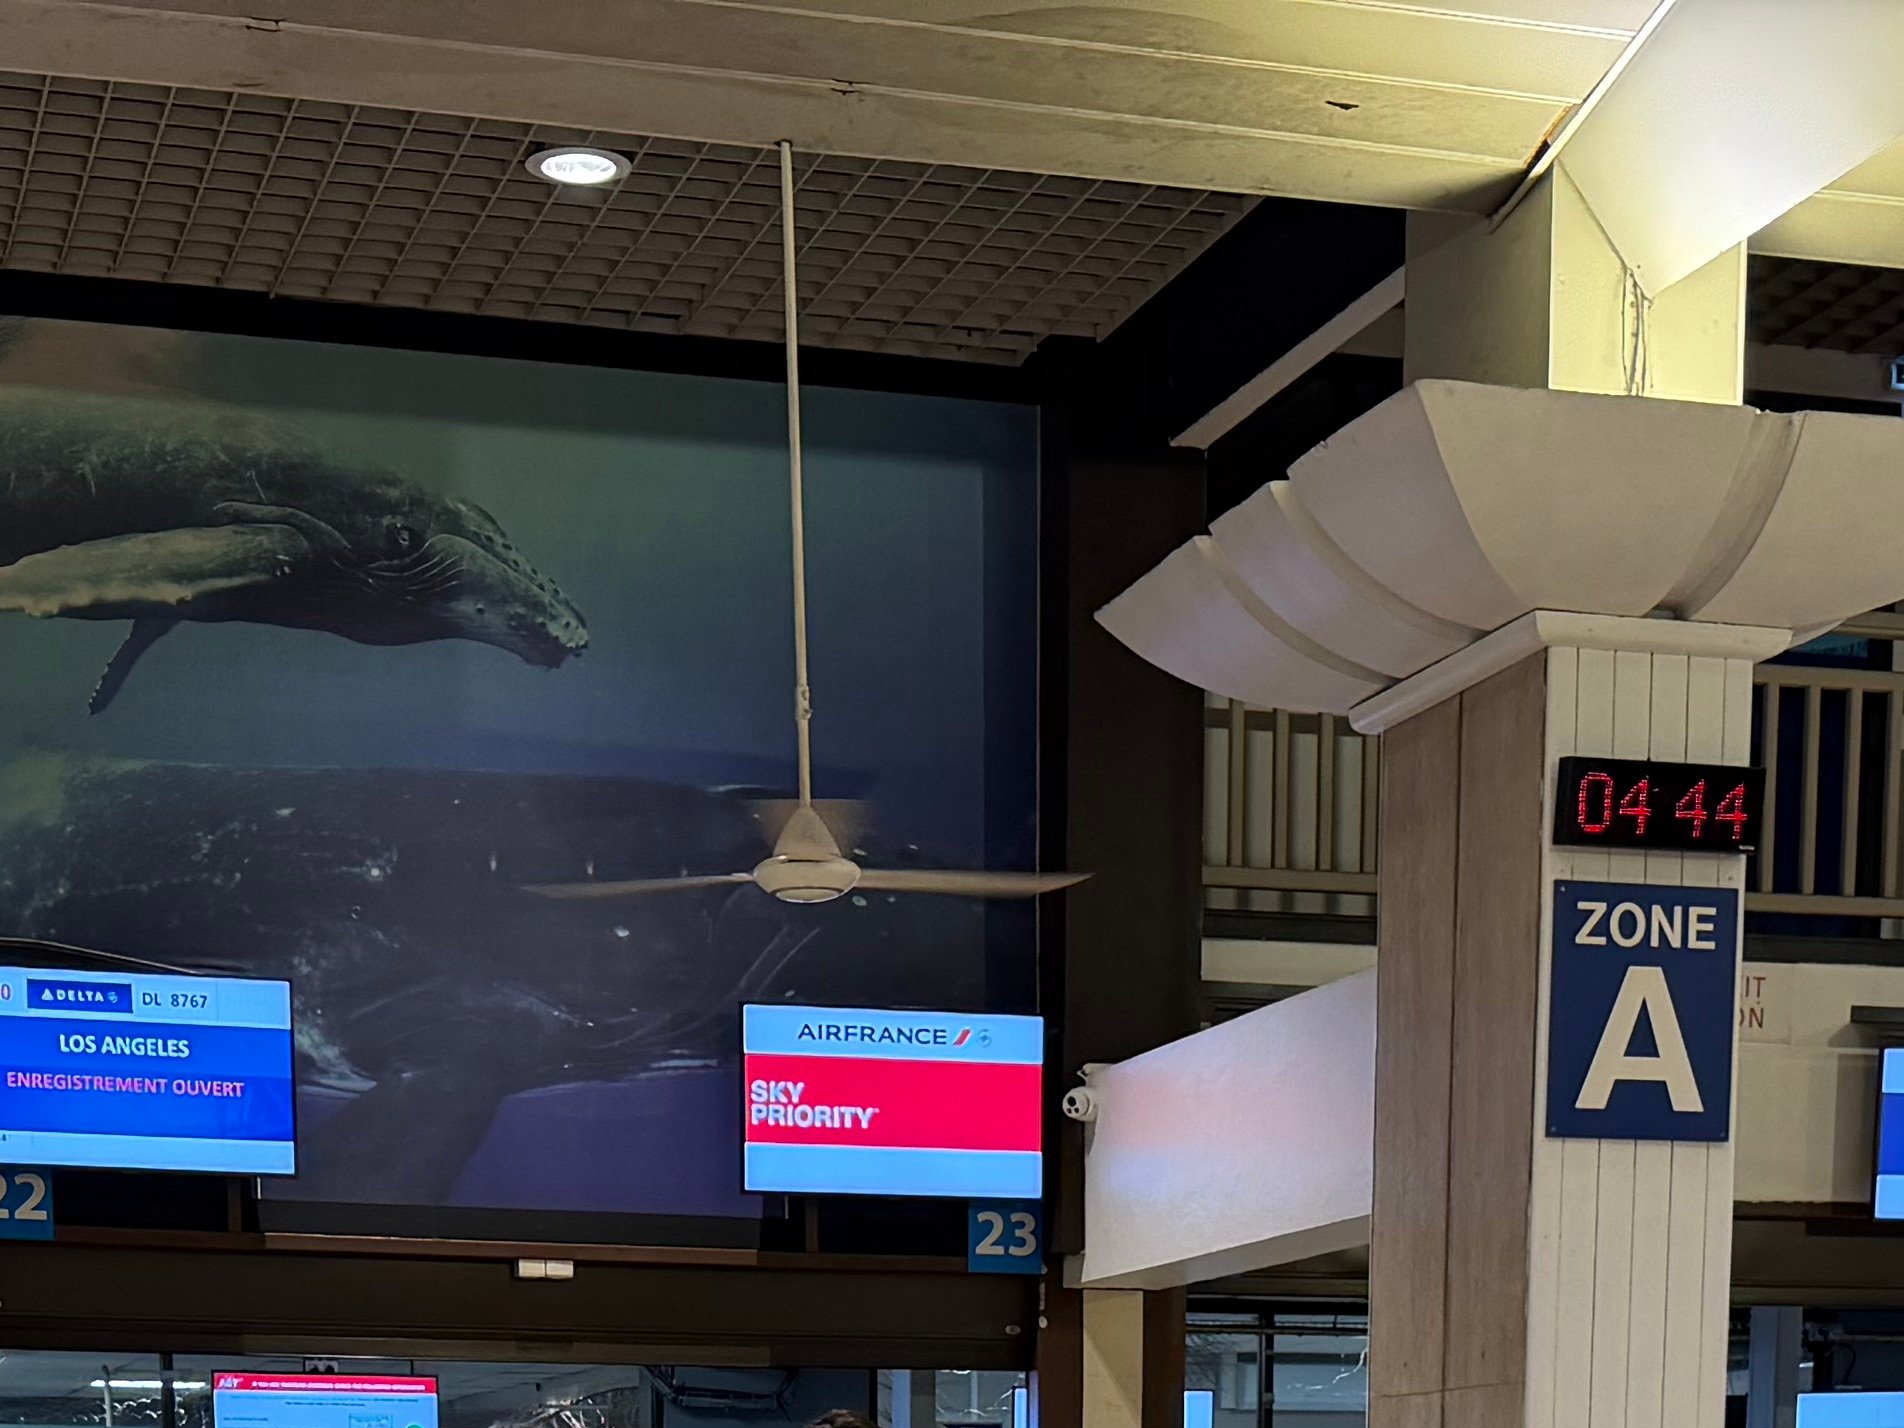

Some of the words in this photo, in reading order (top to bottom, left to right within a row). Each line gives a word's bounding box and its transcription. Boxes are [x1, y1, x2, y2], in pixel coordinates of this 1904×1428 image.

[1574, 901, 1718, 951] ZONE
[56, 990, 105, 1003] DELTA
[142, 992, 162, 1007] DL
[170, 994, 208, 1009] 8767
[59, 1033, 97, 1055] LOS
[100, 1036, 190, 1058] ANGELES
[797, 1023, 948, 1046] AIRFRANCE
[1574, 964, 1705, 1114] A
[6, 1071, 169, 1095] ENREGISTREMENT
[171, 1078, 246, 1098] OUVERT
[750, 1079, 805, 1104] SKY
[974, 1210, 1038, 1257] 23
